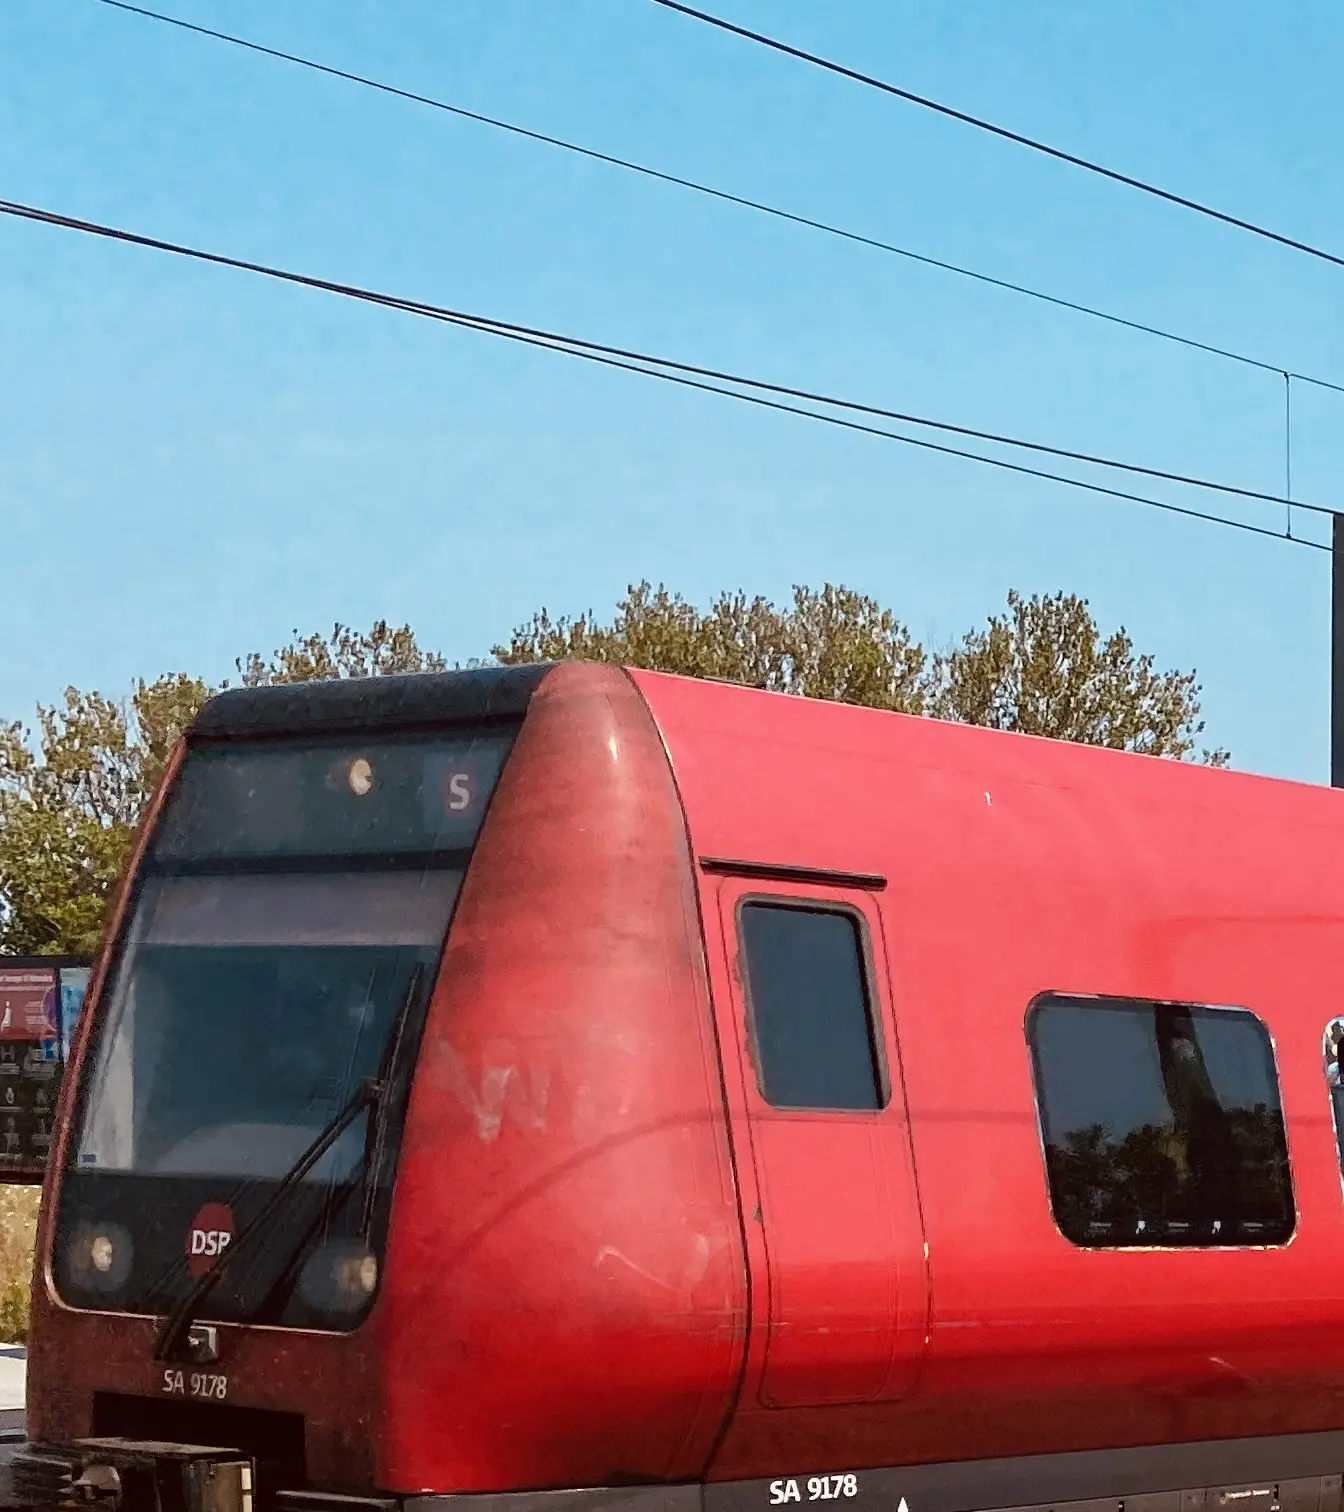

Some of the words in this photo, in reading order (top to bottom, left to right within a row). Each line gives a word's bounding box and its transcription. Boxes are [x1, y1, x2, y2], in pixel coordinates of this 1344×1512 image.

[450, 774, 469, 810] S
[162, 1369, 185, 1394] SA
[190, 1373, 227, 1399] 9178
[769, 1480, 801, 1505] SA
[807, 1474, 858, 1501] 9178
